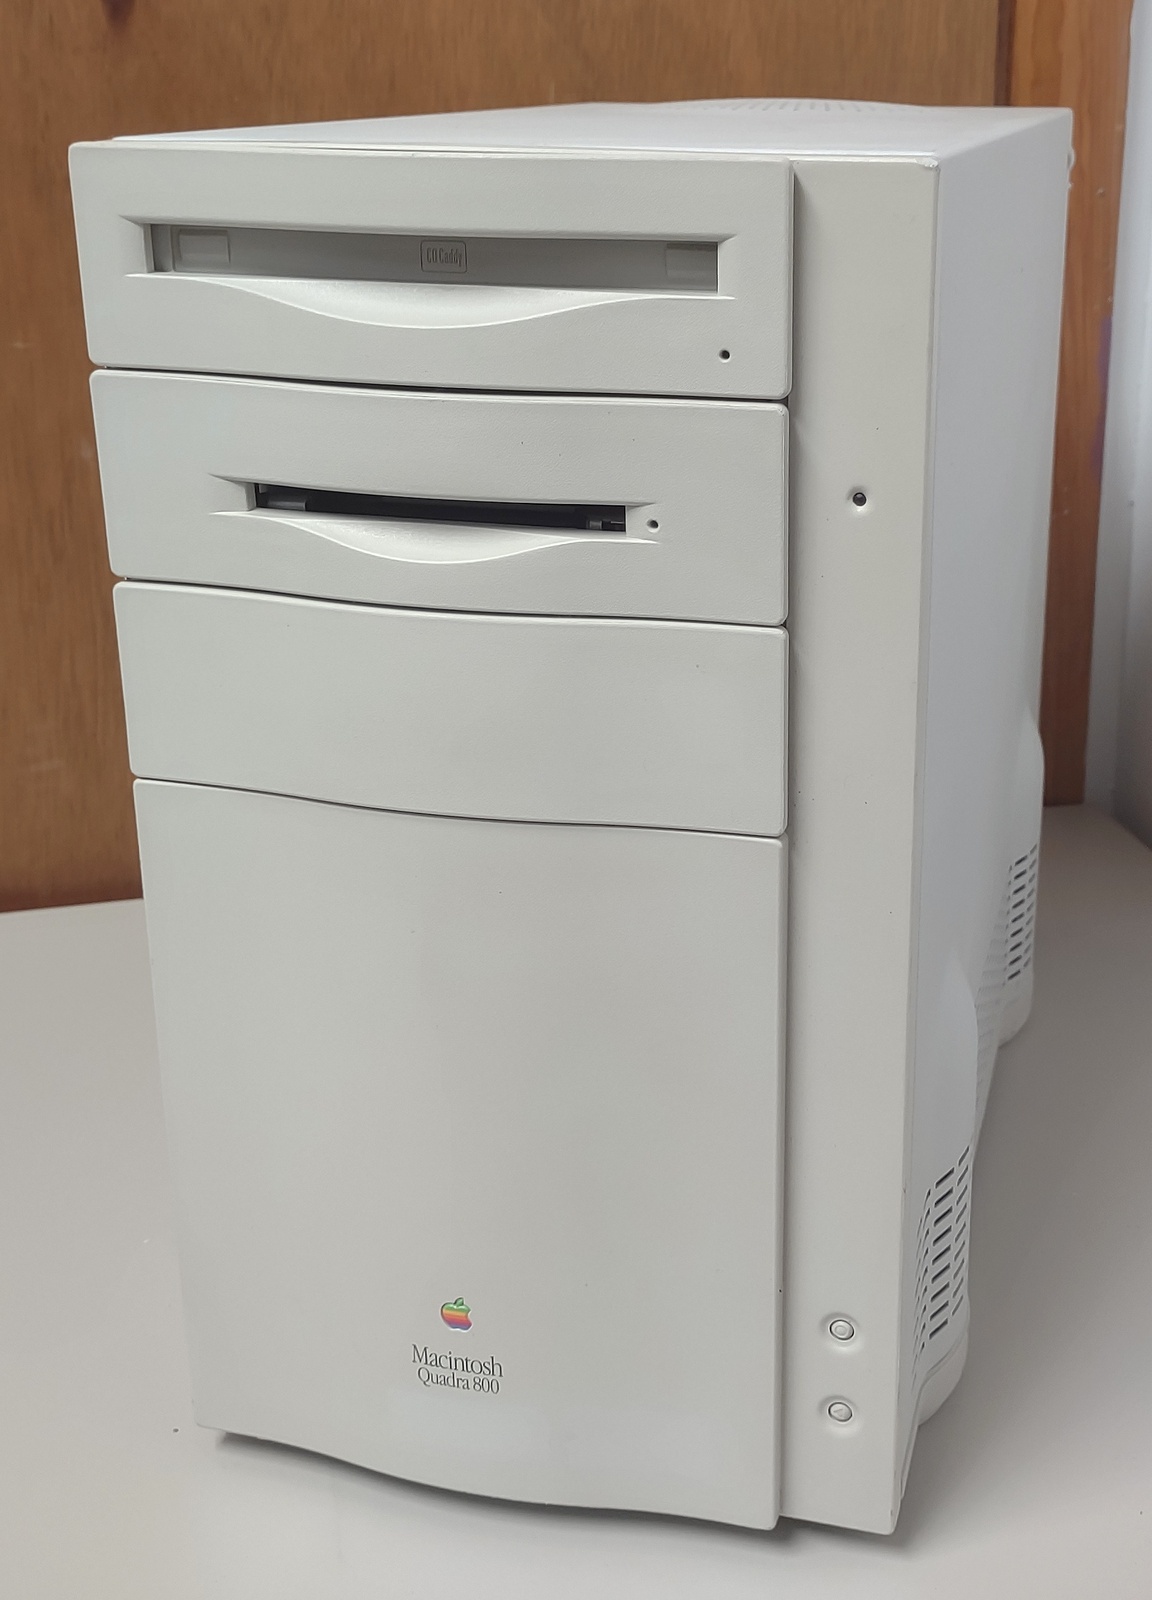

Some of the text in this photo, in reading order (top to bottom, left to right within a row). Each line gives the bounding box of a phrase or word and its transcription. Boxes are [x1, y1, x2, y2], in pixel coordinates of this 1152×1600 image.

[438, 247, 462, 267] Caddy
[412, 1343, 503, 1377] Macintosh
[417, 1366, 500, 1394] Quadra 800
